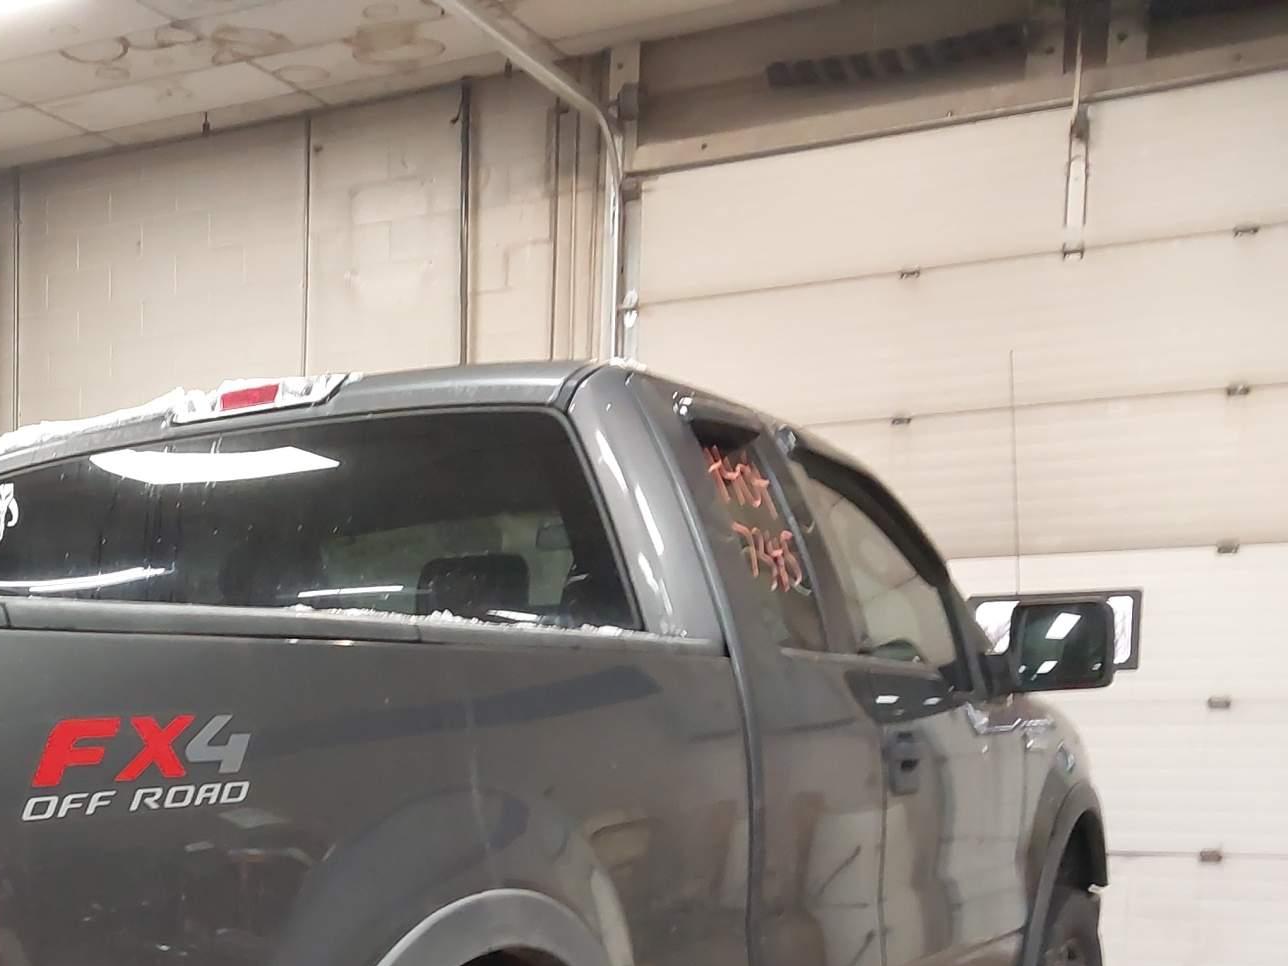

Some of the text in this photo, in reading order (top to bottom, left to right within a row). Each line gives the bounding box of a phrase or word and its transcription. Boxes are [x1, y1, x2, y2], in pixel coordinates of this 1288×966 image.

[32, 714, 251, 787] FX4
[21, 780, 251, 822] OFF ROAD
